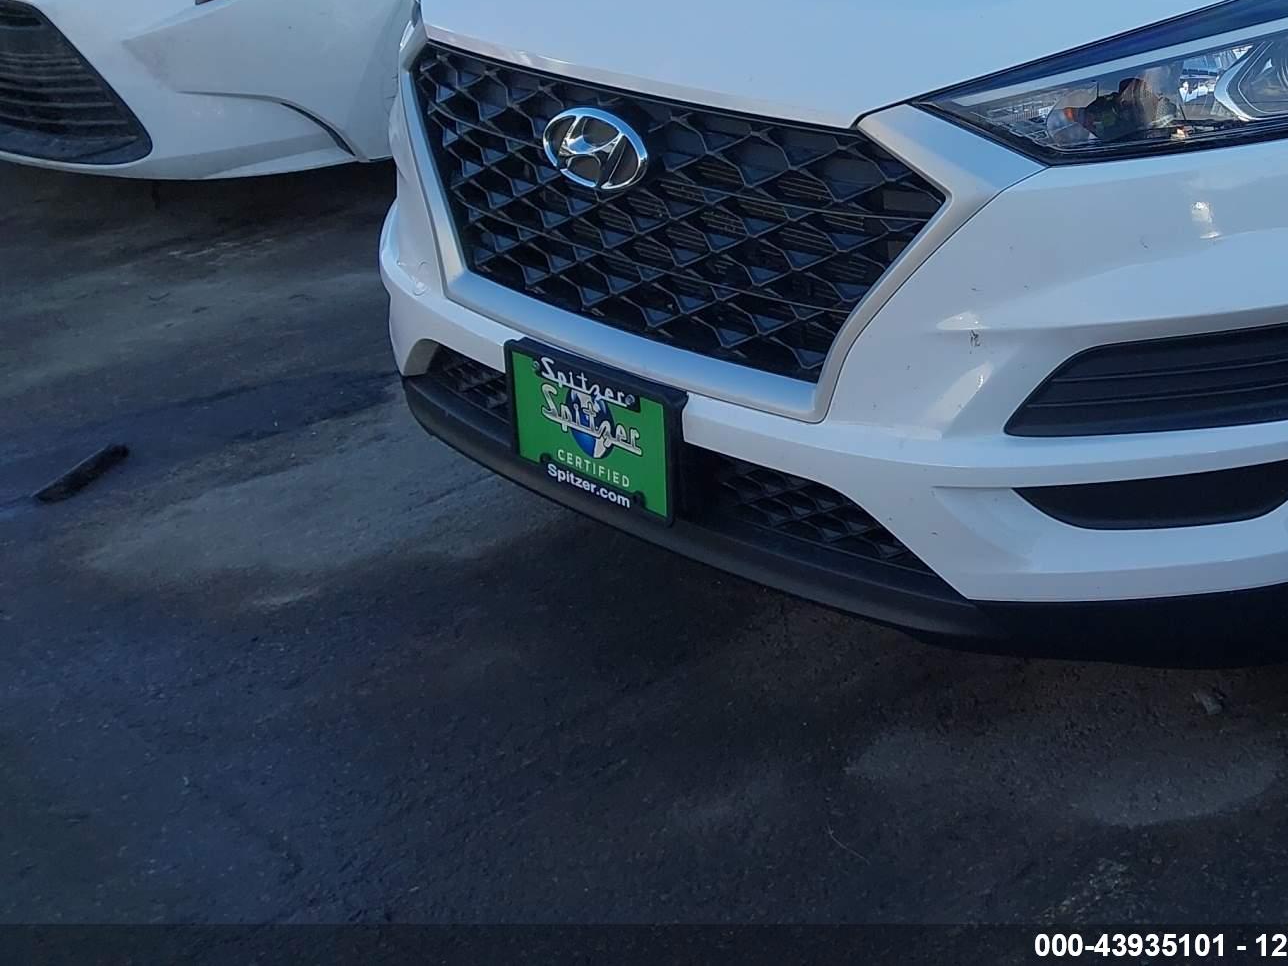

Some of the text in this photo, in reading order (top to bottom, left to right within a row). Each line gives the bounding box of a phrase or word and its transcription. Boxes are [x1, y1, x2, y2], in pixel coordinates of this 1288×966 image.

[539, 356, 629, 408] Spitzer
[540, 382, 643, 456] Spitzer
[547, 463, 631, 509] Spitzer.com
[557, 449, 631, 488] CERTIFIED
